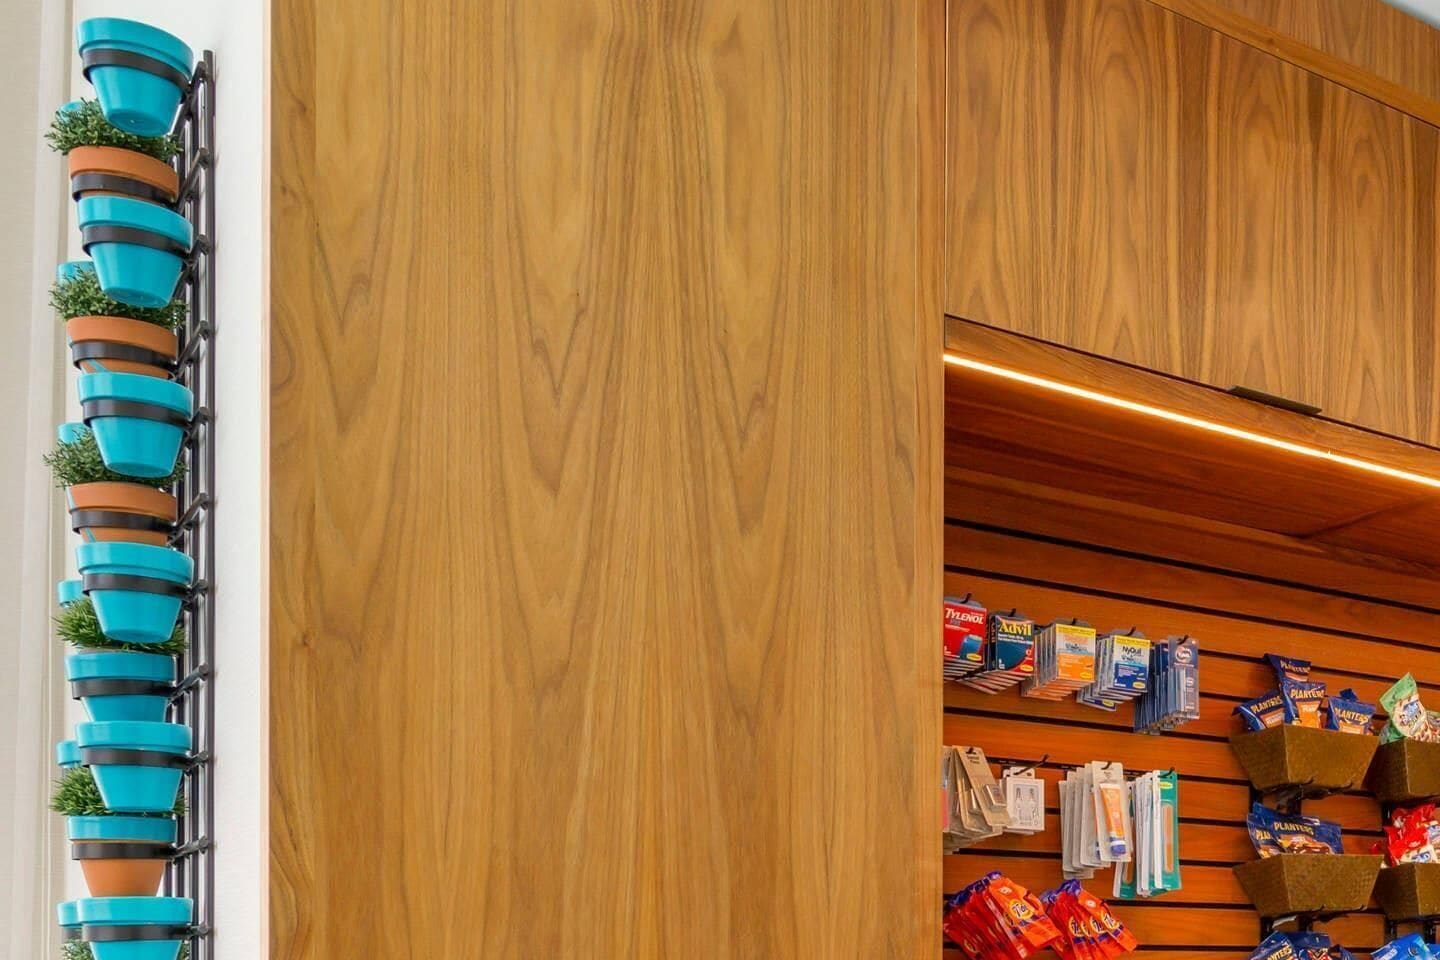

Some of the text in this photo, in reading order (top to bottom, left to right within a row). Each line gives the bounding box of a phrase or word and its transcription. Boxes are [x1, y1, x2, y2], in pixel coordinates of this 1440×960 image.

[945, 607, 984, 624] TYLENOL
[999, 621, 1032, 636] Advil
[1273, 822, 1314, 836] PLANTERS
